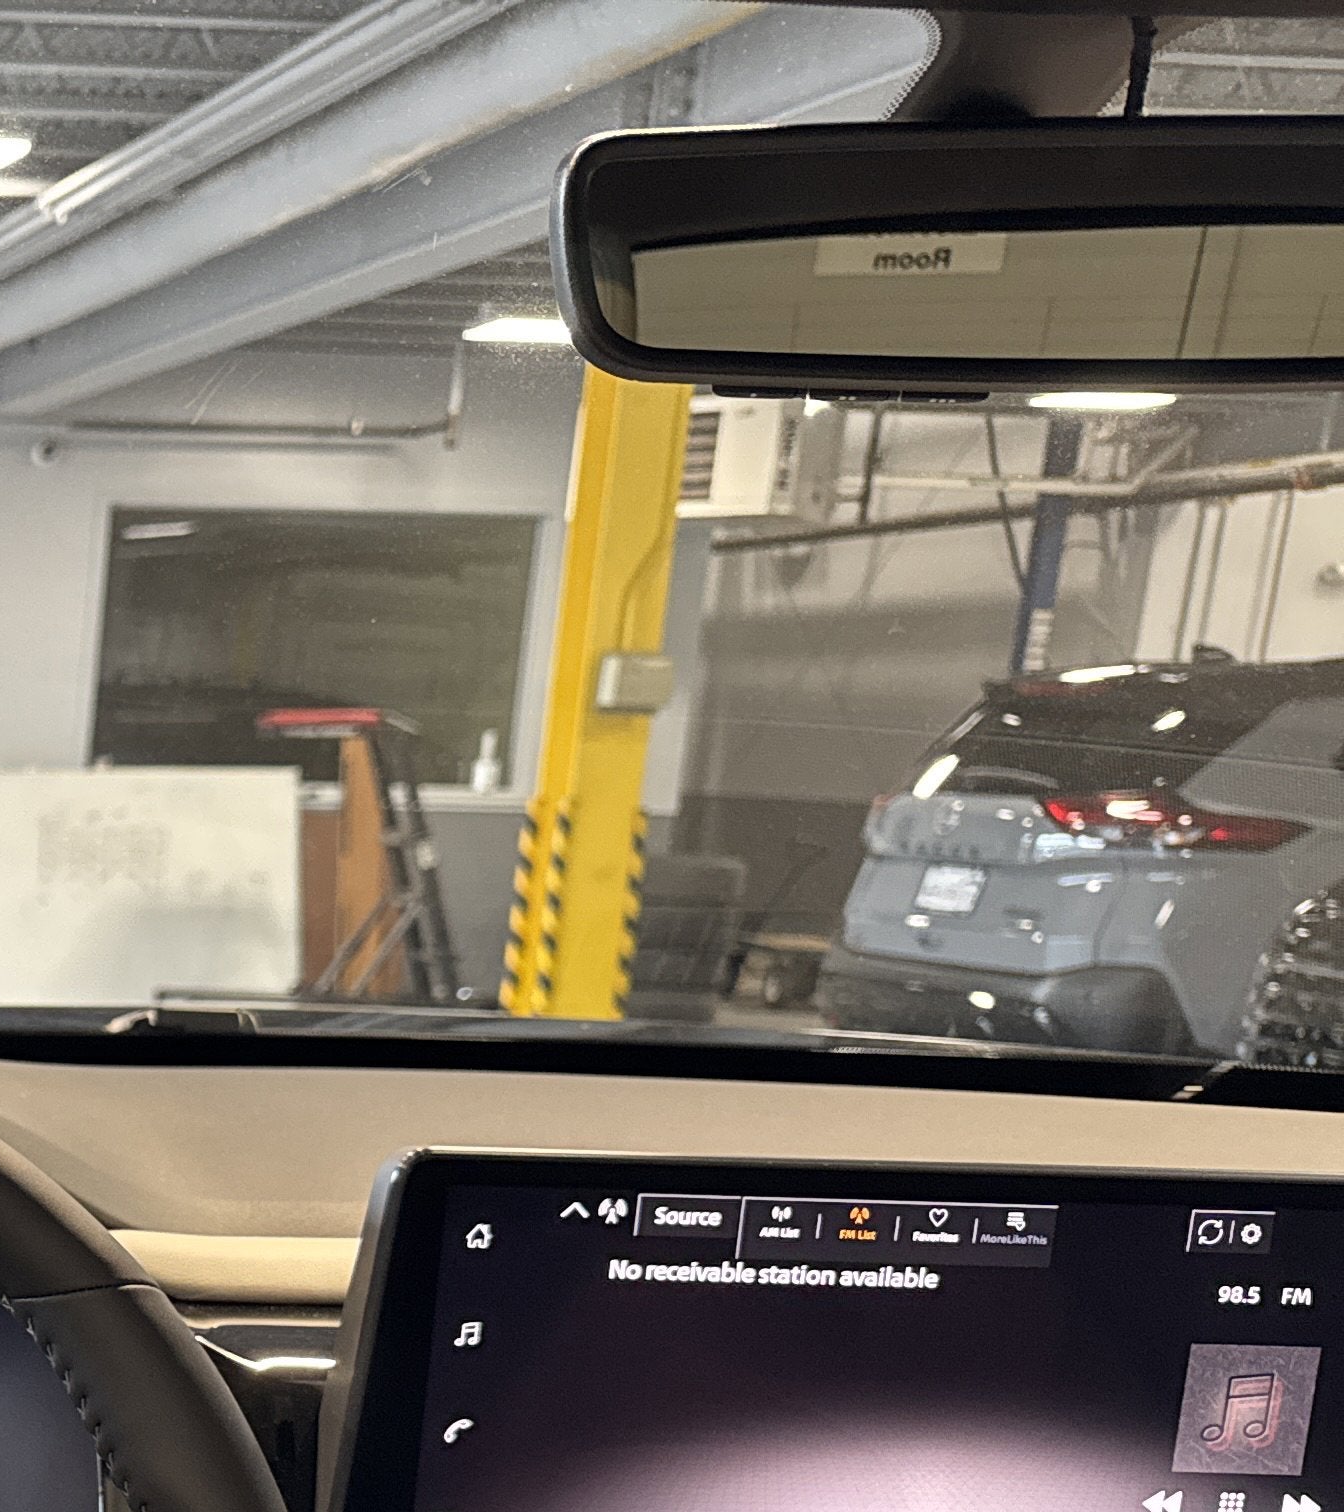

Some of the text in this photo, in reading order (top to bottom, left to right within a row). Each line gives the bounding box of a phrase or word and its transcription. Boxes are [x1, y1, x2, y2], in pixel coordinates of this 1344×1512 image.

[653, 1206, 723, 1227] Source
[838, 1229, 878, 1241] FM List
[912, 1230, 960, 1244] Favorites
[979, 1232, 1048, 1246] MoreLikeThis
[608, 1259, 940, 1290] No receivable station available
[1217, 1285, 1312, 1306] 98.5 FM
